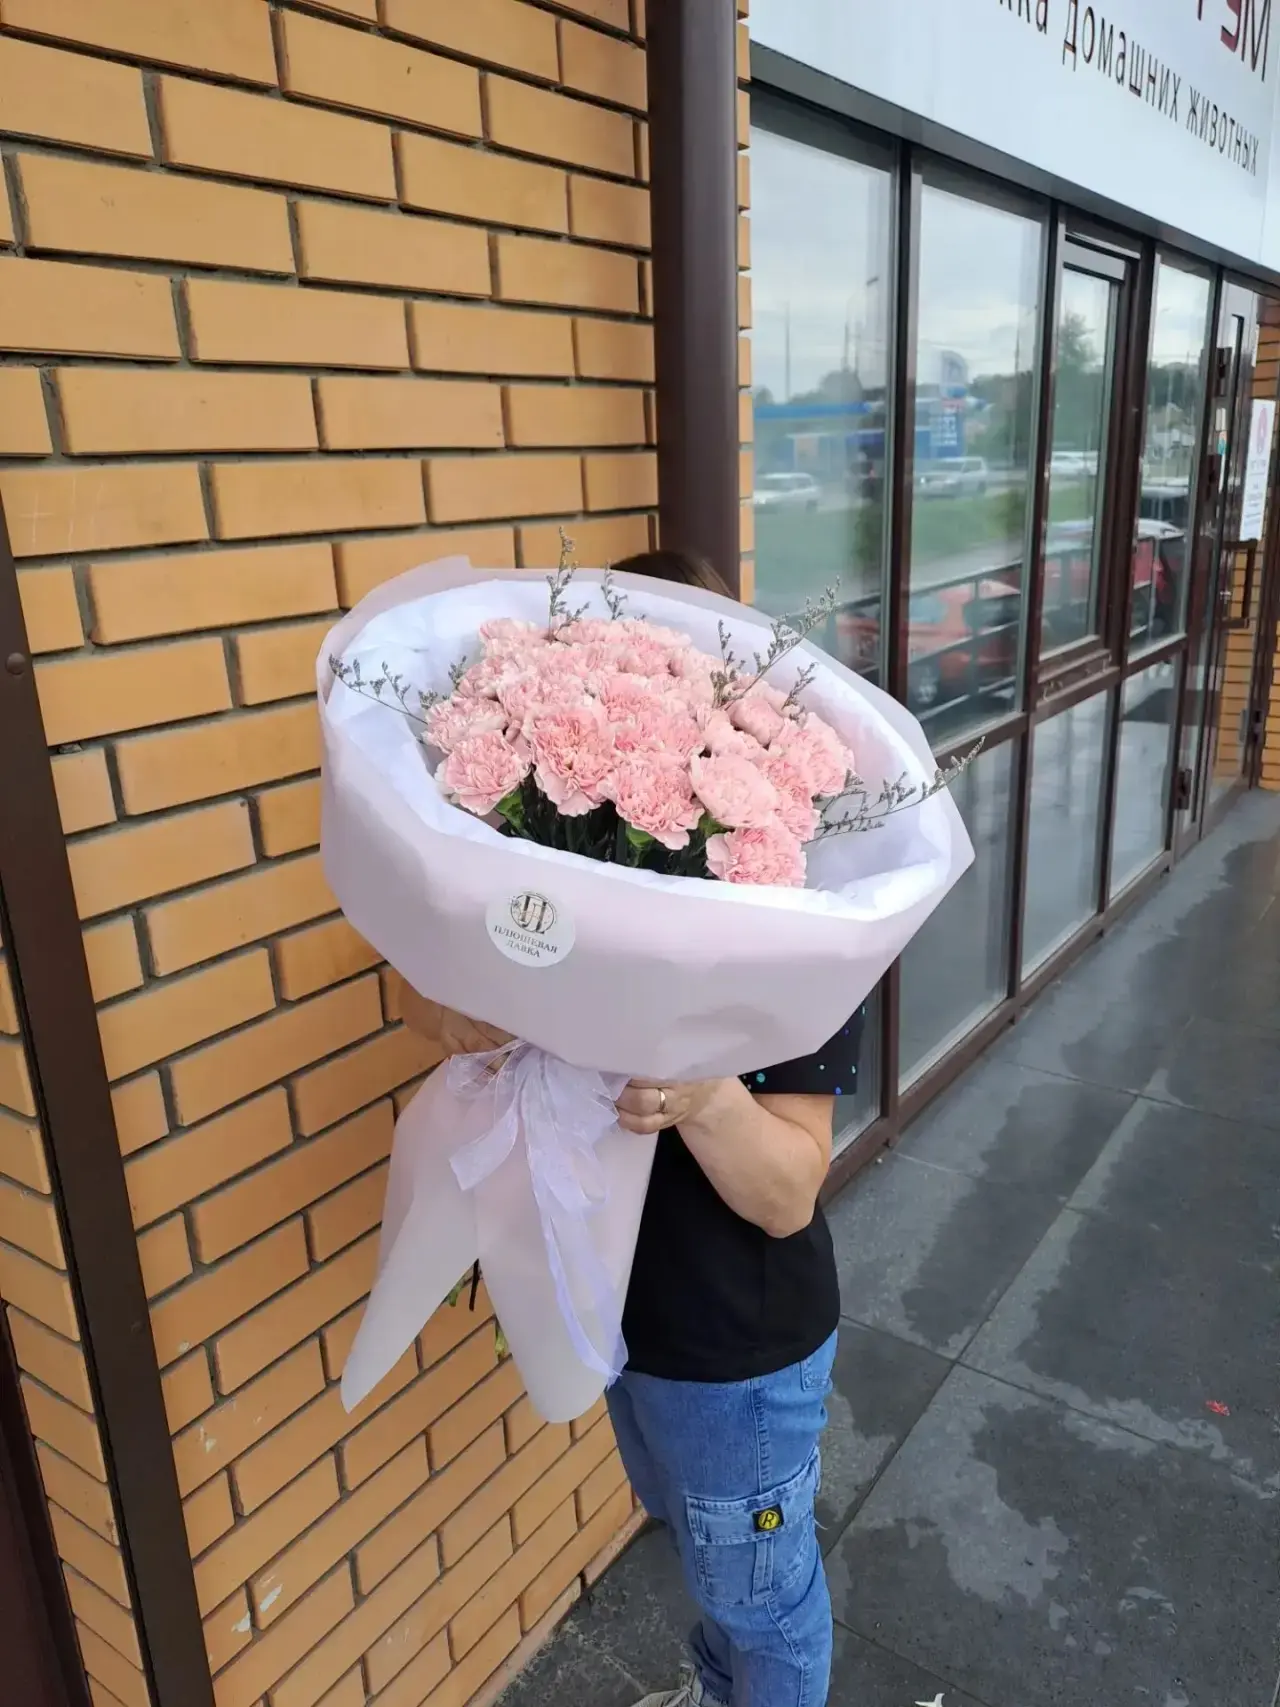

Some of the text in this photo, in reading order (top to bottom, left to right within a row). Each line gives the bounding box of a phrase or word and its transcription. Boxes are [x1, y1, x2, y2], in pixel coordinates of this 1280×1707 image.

[1186, 84, 1259, 176] животных
[494, 924, 558, 954] ПЛЮШЕВАЯ
[504, 939, 541, 958] ЛАВКА
